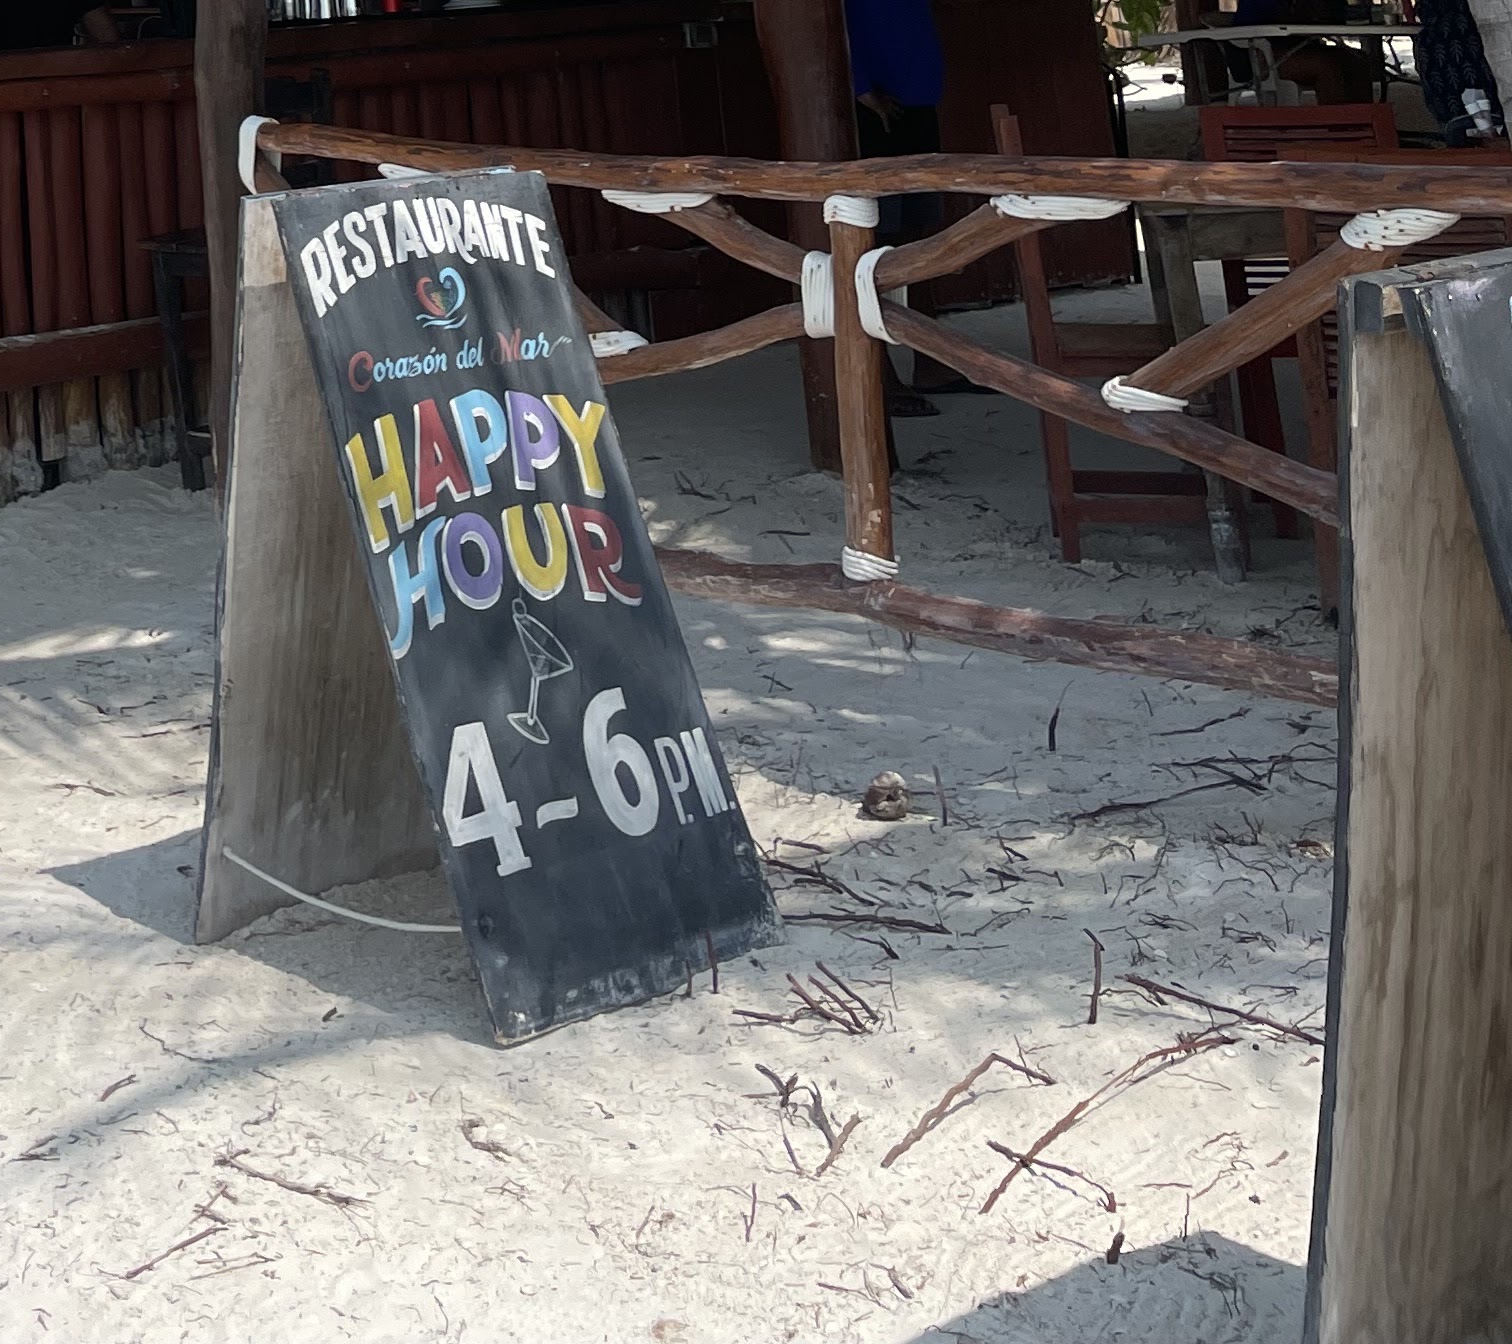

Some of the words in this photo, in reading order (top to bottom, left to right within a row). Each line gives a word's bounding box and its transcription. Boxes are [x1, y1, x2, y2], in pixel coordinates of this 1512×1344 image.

[299, 196, 555, 318] RESTAURANTE
[348, 347, 447, 392] Corazón
[456, 337, 484, 369] del
[496, 328, 562, 362] Mar
[345, 389, 605, 553] HAPPY
[388, 503, 641, 659] HOUR
